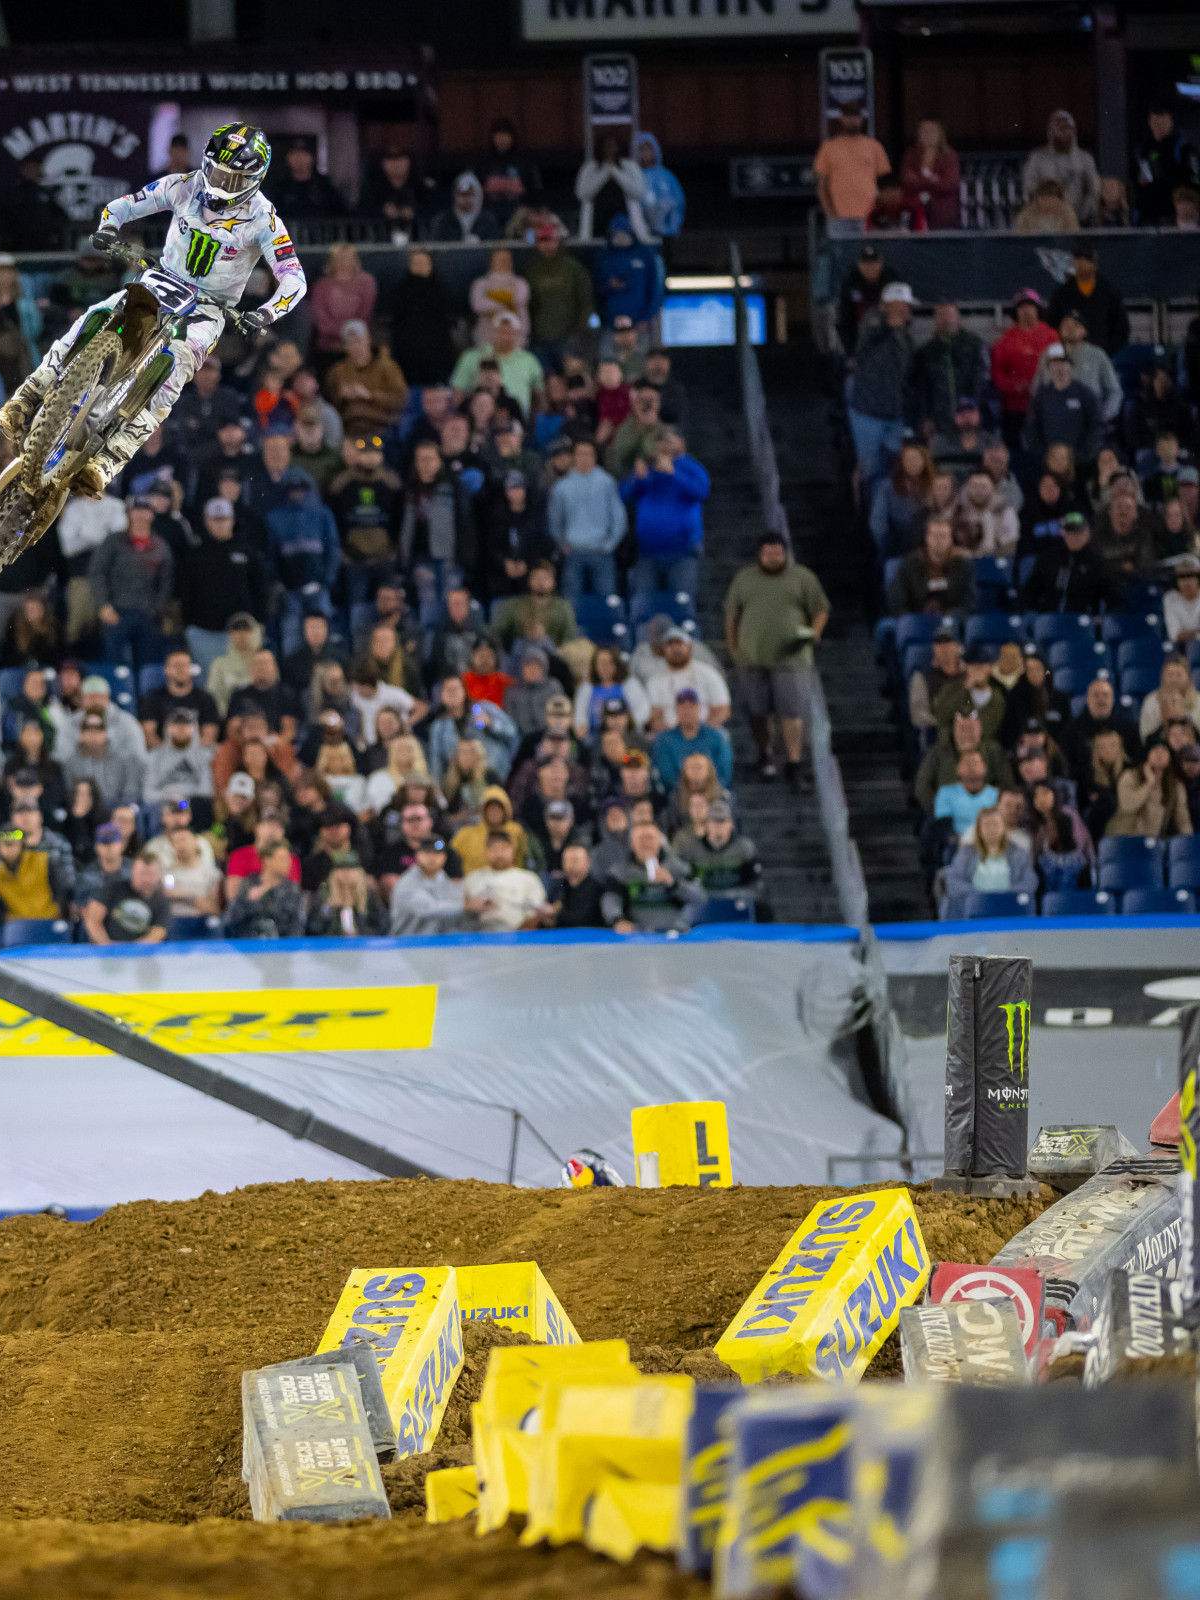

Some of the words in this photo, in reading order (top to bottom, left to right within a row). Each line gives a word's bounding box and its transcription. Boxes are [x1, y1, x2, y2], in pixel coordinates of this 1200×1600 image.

[547, 0, 831, 19] MARTINS
[11, 73, 72, 92] WEST
[78, 72, 201, 91] TENNESSEE
[206, 71, 288, 91] WHOLE
[295, 70, 349, 91] HOG
[354, 70, 403, 91] BBQ
[591, 65, 630, 85] 102
[829, 60, 865, 80] 103
[2, 112, 141, 159] MARTIN'S
[987, 1086, 1029, 1102] MONST
[1137, 1217, 1183, 1273] MOUNT
[734, 1200, 876, 1339] SUZUKI
[461, 1306, 529, 1320] UZUKI
[815, 1216, 926, 1382] SUZUKI
[917, 1306, 962, 1383] MOUNTAIN
[278, 1375, 300, 1403] CROSS
[296, 1375, 318, 1400] MOTO
[314, 1372, 335, 1400] SUPER
[398, 1299, 463, 1458] SUZUKI
[295, 1441, 316, 1470] CROSS
[312, 1441, 334, 1467] MOTO
[330, 1438, 352, 1467] SUPER
